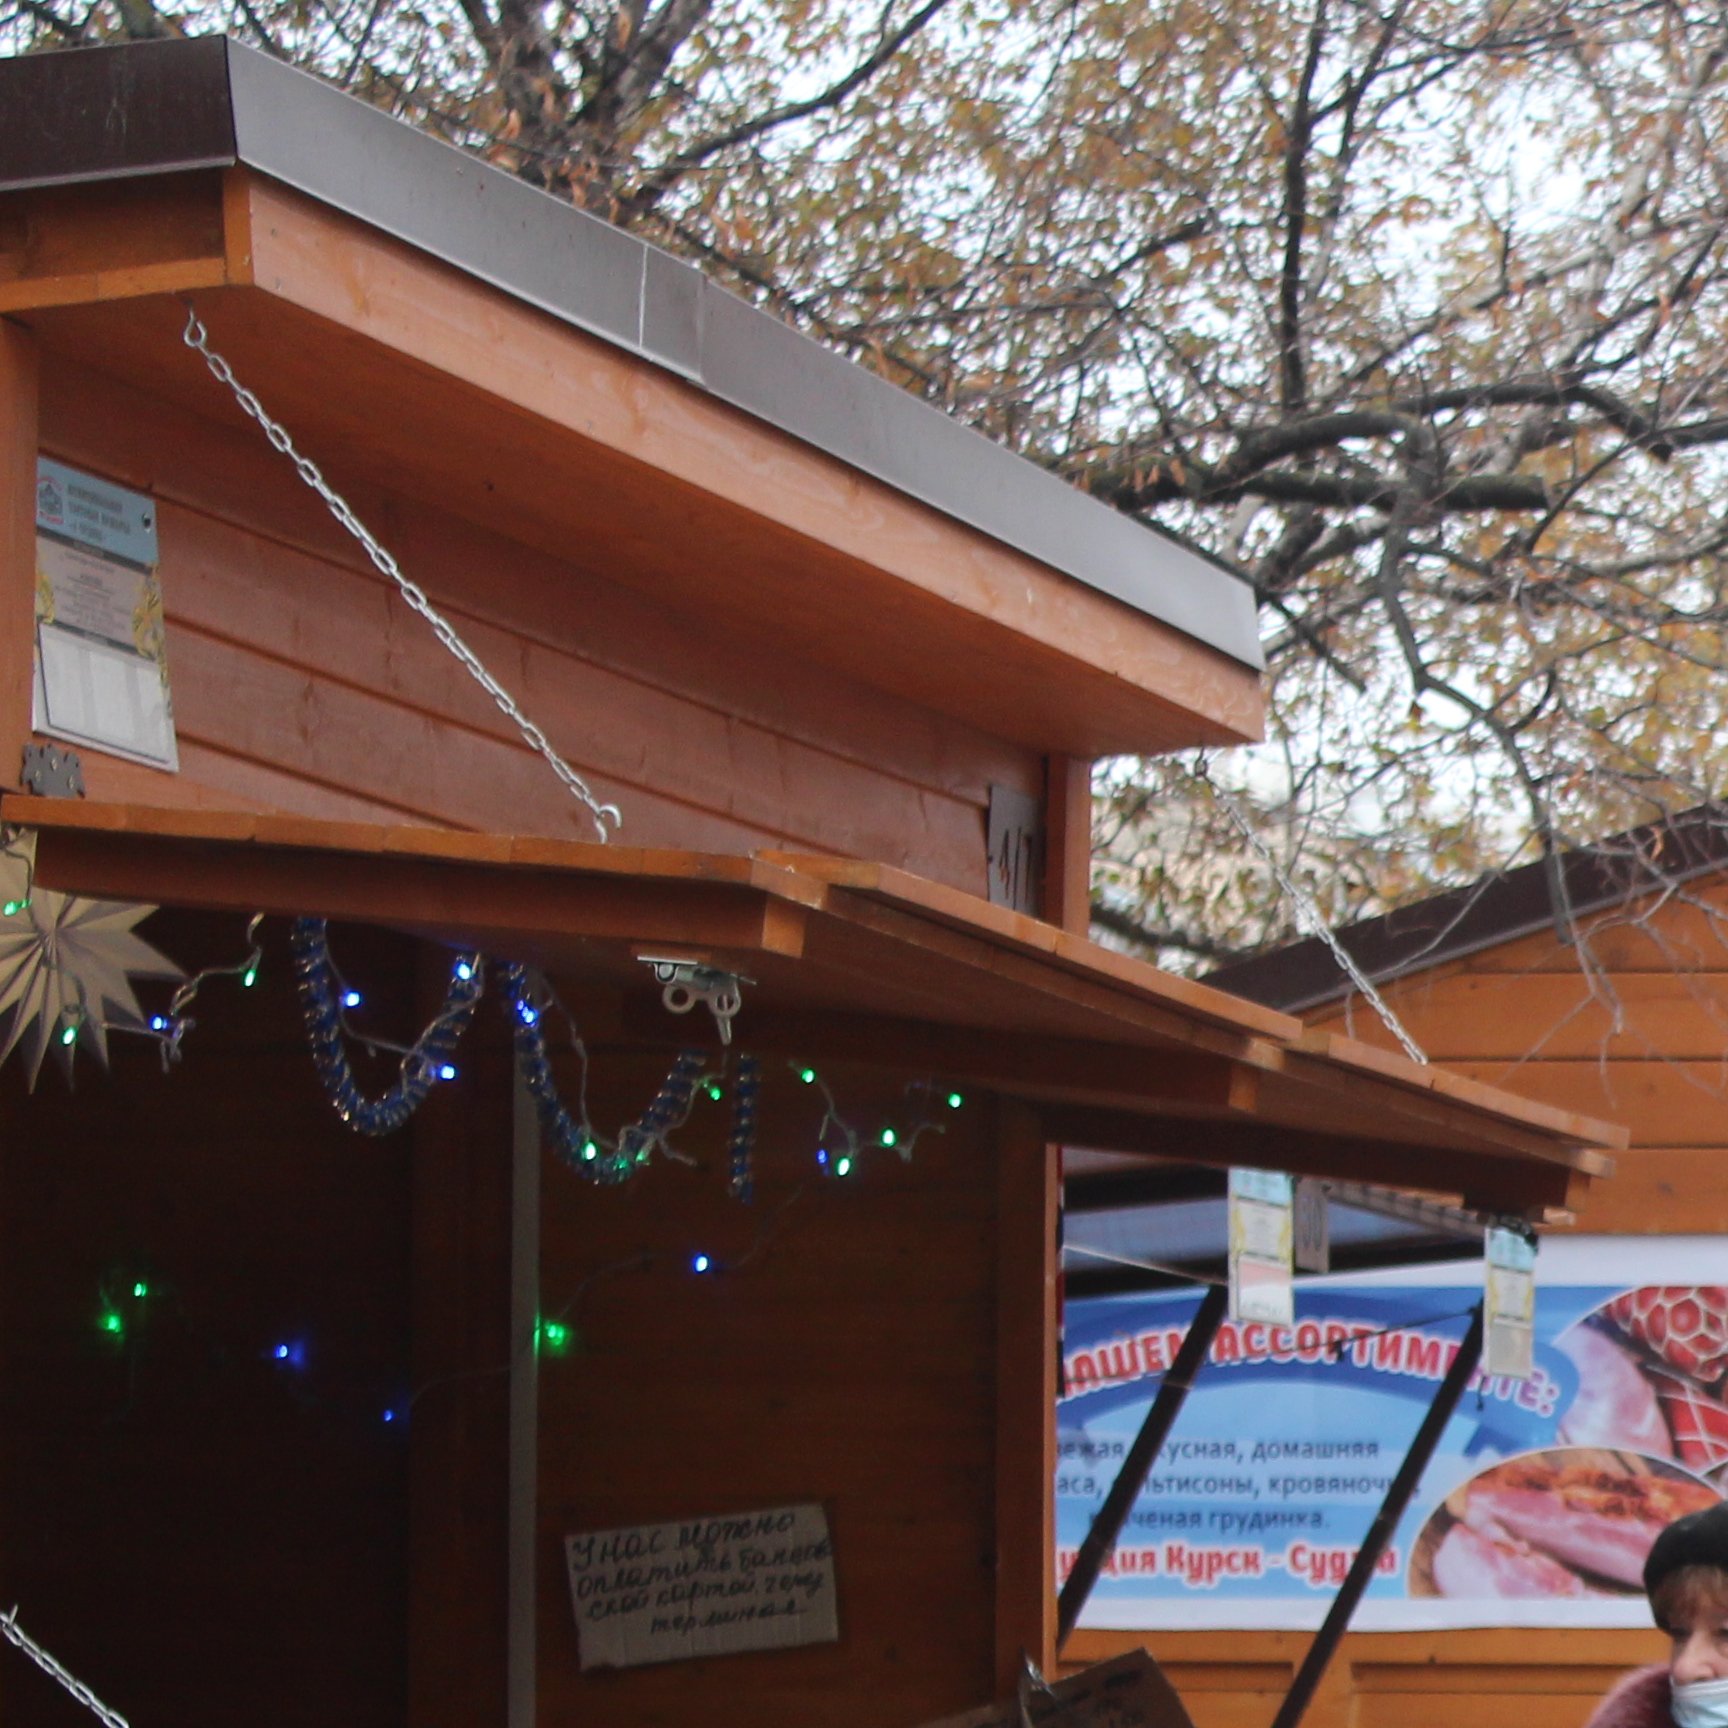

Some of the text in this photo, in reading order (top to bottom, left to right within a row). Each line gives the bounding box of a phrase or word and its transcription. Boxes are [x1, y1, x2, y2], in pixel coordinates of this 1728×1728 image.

[1064, 1322, 1557, 1415] АШЕ АССОРТИМЕ:
[1160, 1441, 1243, 1464] усная,
[1251, 1440, 1379, 1462] домашняя
[1269, 1475, 1421, 1499] кровяноч,
[1166, 1544, 1262, 1583] Курск
[1290, 1545, 1397, 1586] Суда
